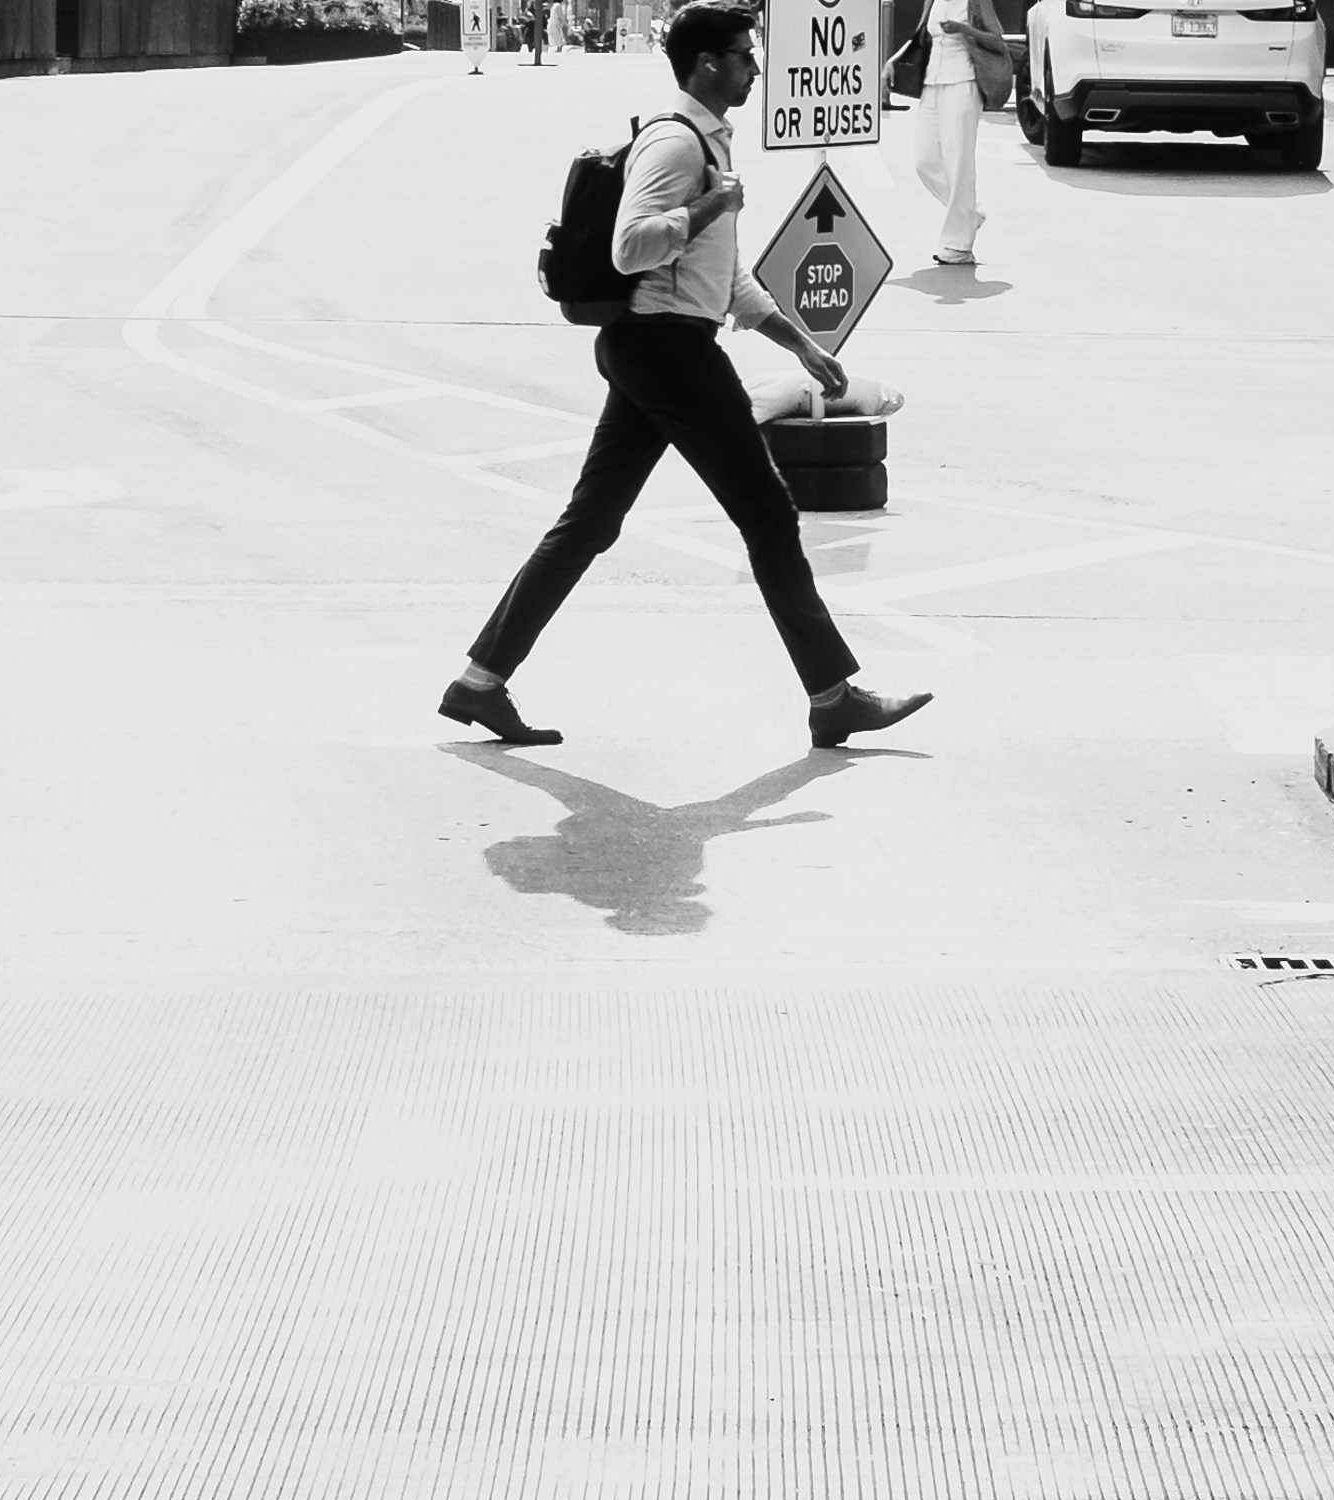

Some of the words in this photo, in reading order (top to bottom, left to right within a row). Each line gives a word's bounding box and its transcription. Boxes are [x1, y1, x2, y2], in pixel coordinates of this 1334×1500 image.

[811, 15, 845, 57] NO
[787, 64, 862, 98] TRUCKS
[774, 107, 802, 139] OR
[813, 103, 873, 138] BUSES
[807, 264, 843, 285] STOP
[799, 288, 849, 310] AHEAD
